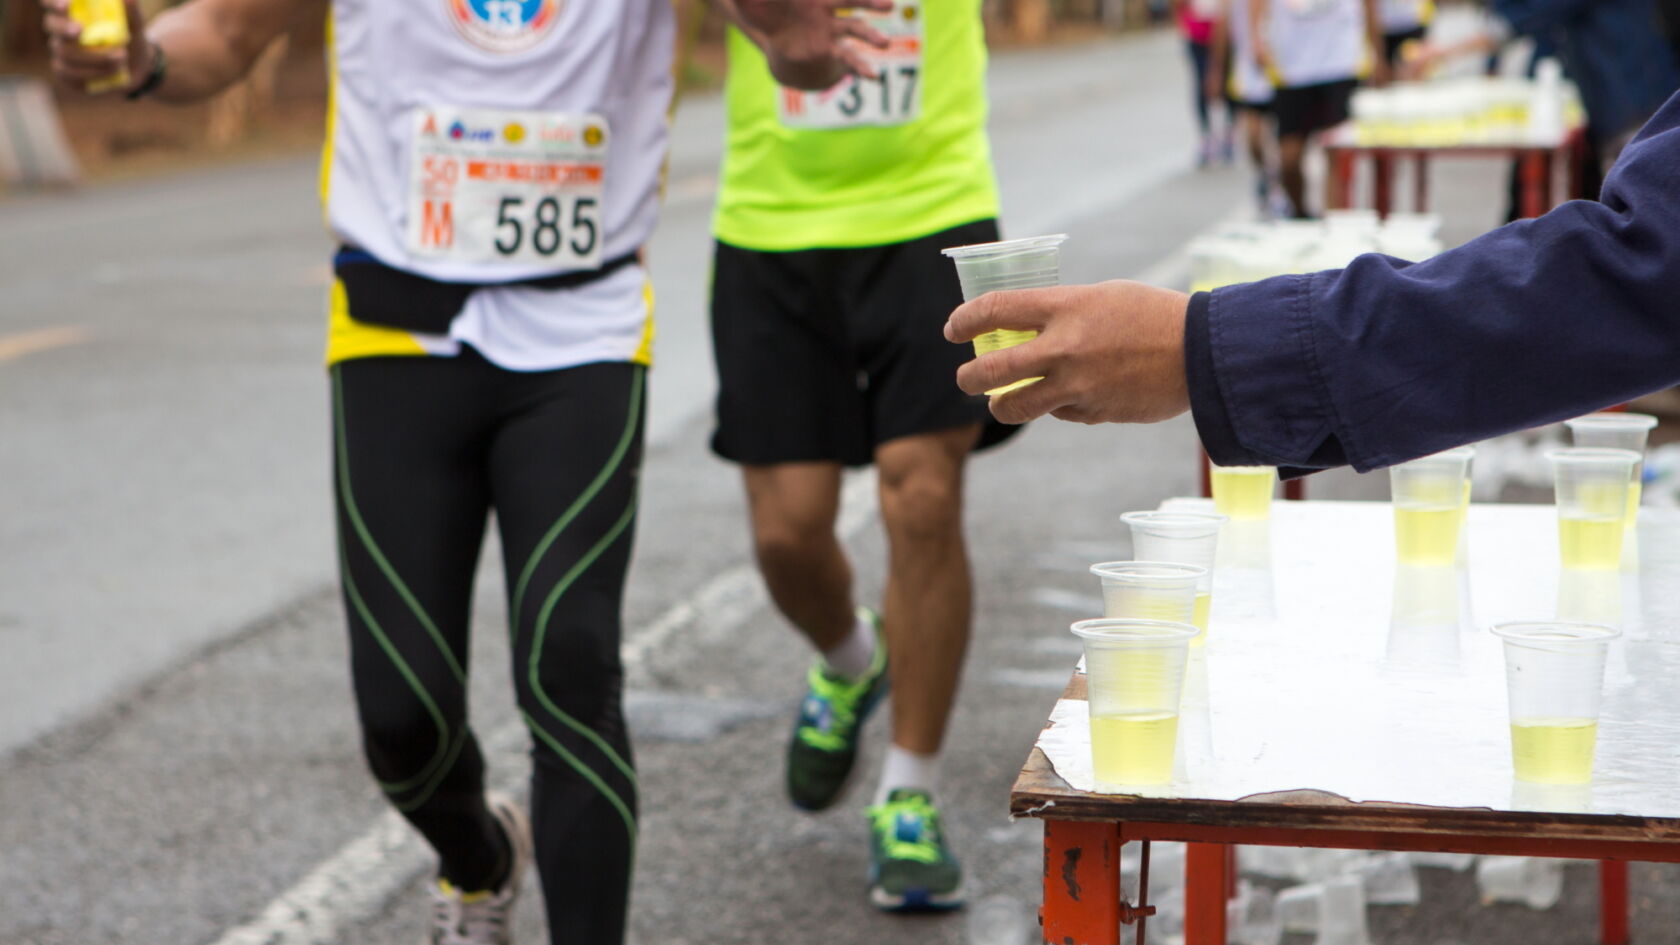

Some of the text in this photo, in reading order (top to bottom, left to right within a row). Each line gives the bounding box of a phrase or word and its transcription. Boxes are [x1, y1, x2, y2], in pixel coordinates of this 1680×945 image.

[837, 67, 917, 117] 317
[421, 115, 438, 137] A
[421, 200, 454, 247] M
[494, 196, 597, 256] 585
